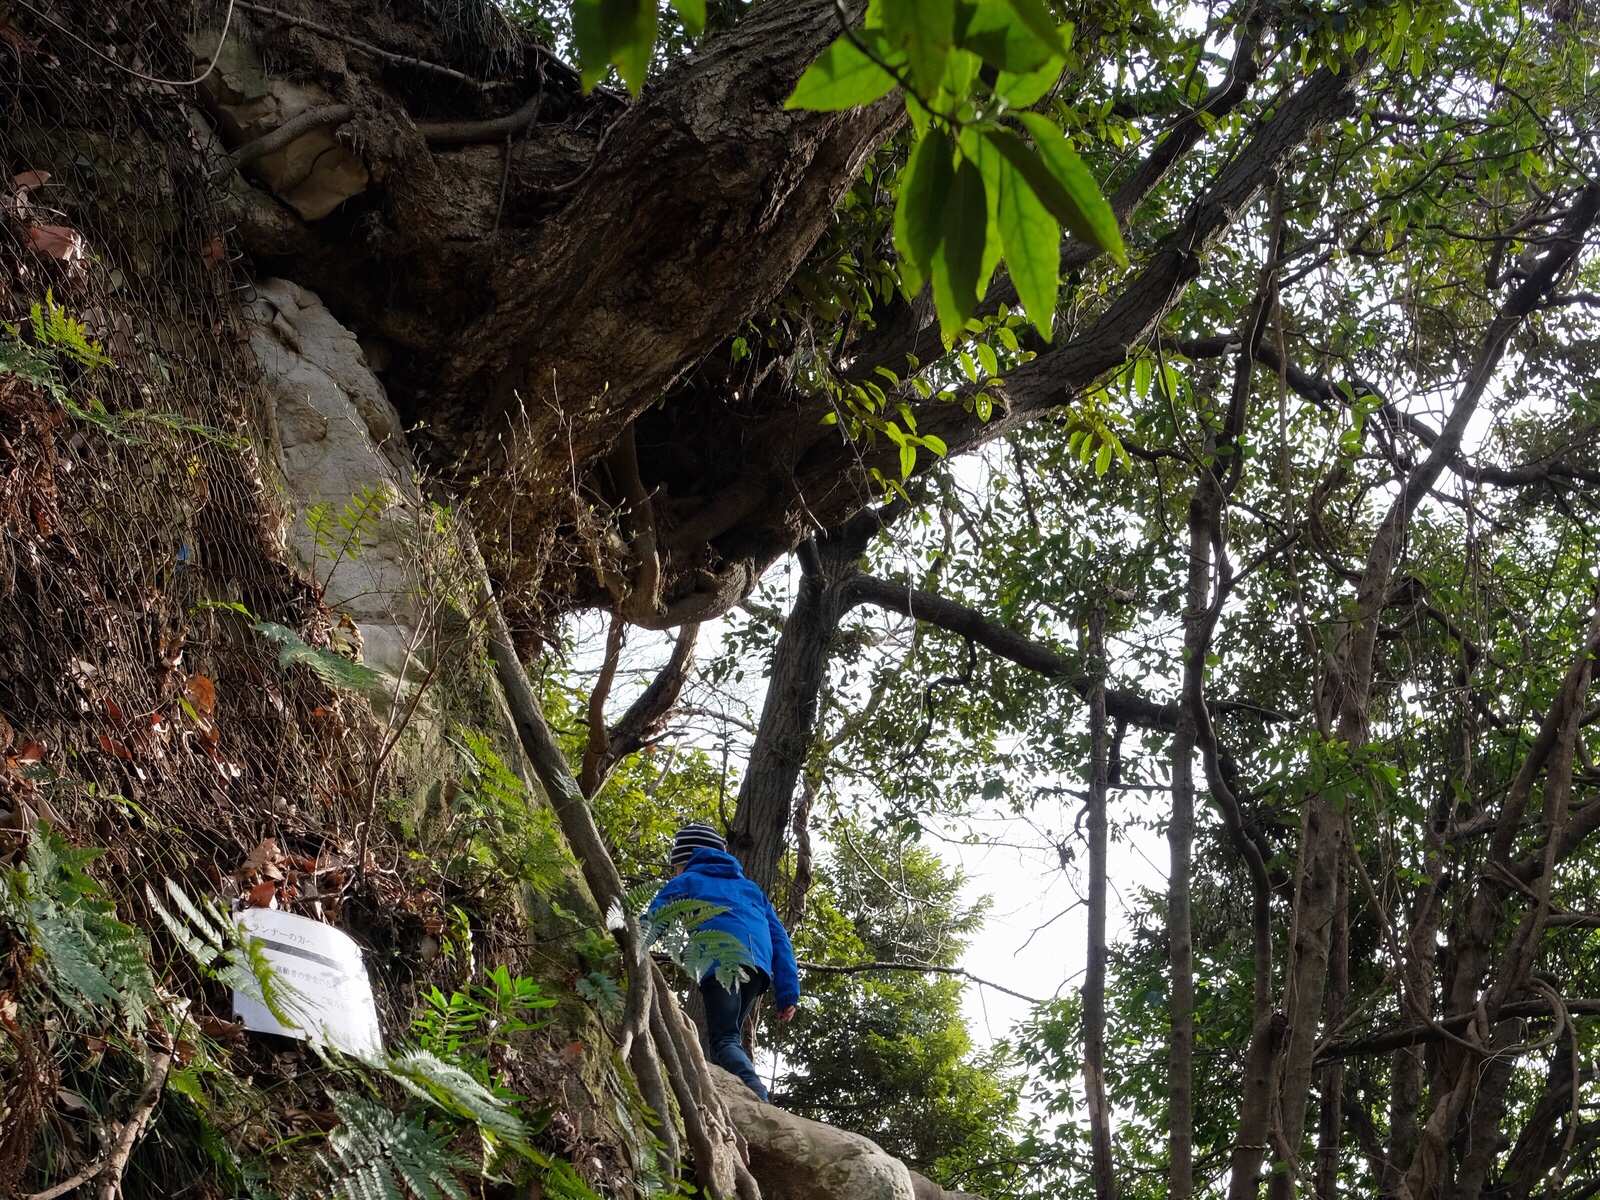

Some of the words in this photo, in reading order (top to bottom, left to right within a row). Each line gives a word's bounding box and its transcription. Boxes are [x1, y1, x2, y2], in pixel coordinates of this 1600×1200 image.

[252, 922, 315, 946] ランナーの方へ
